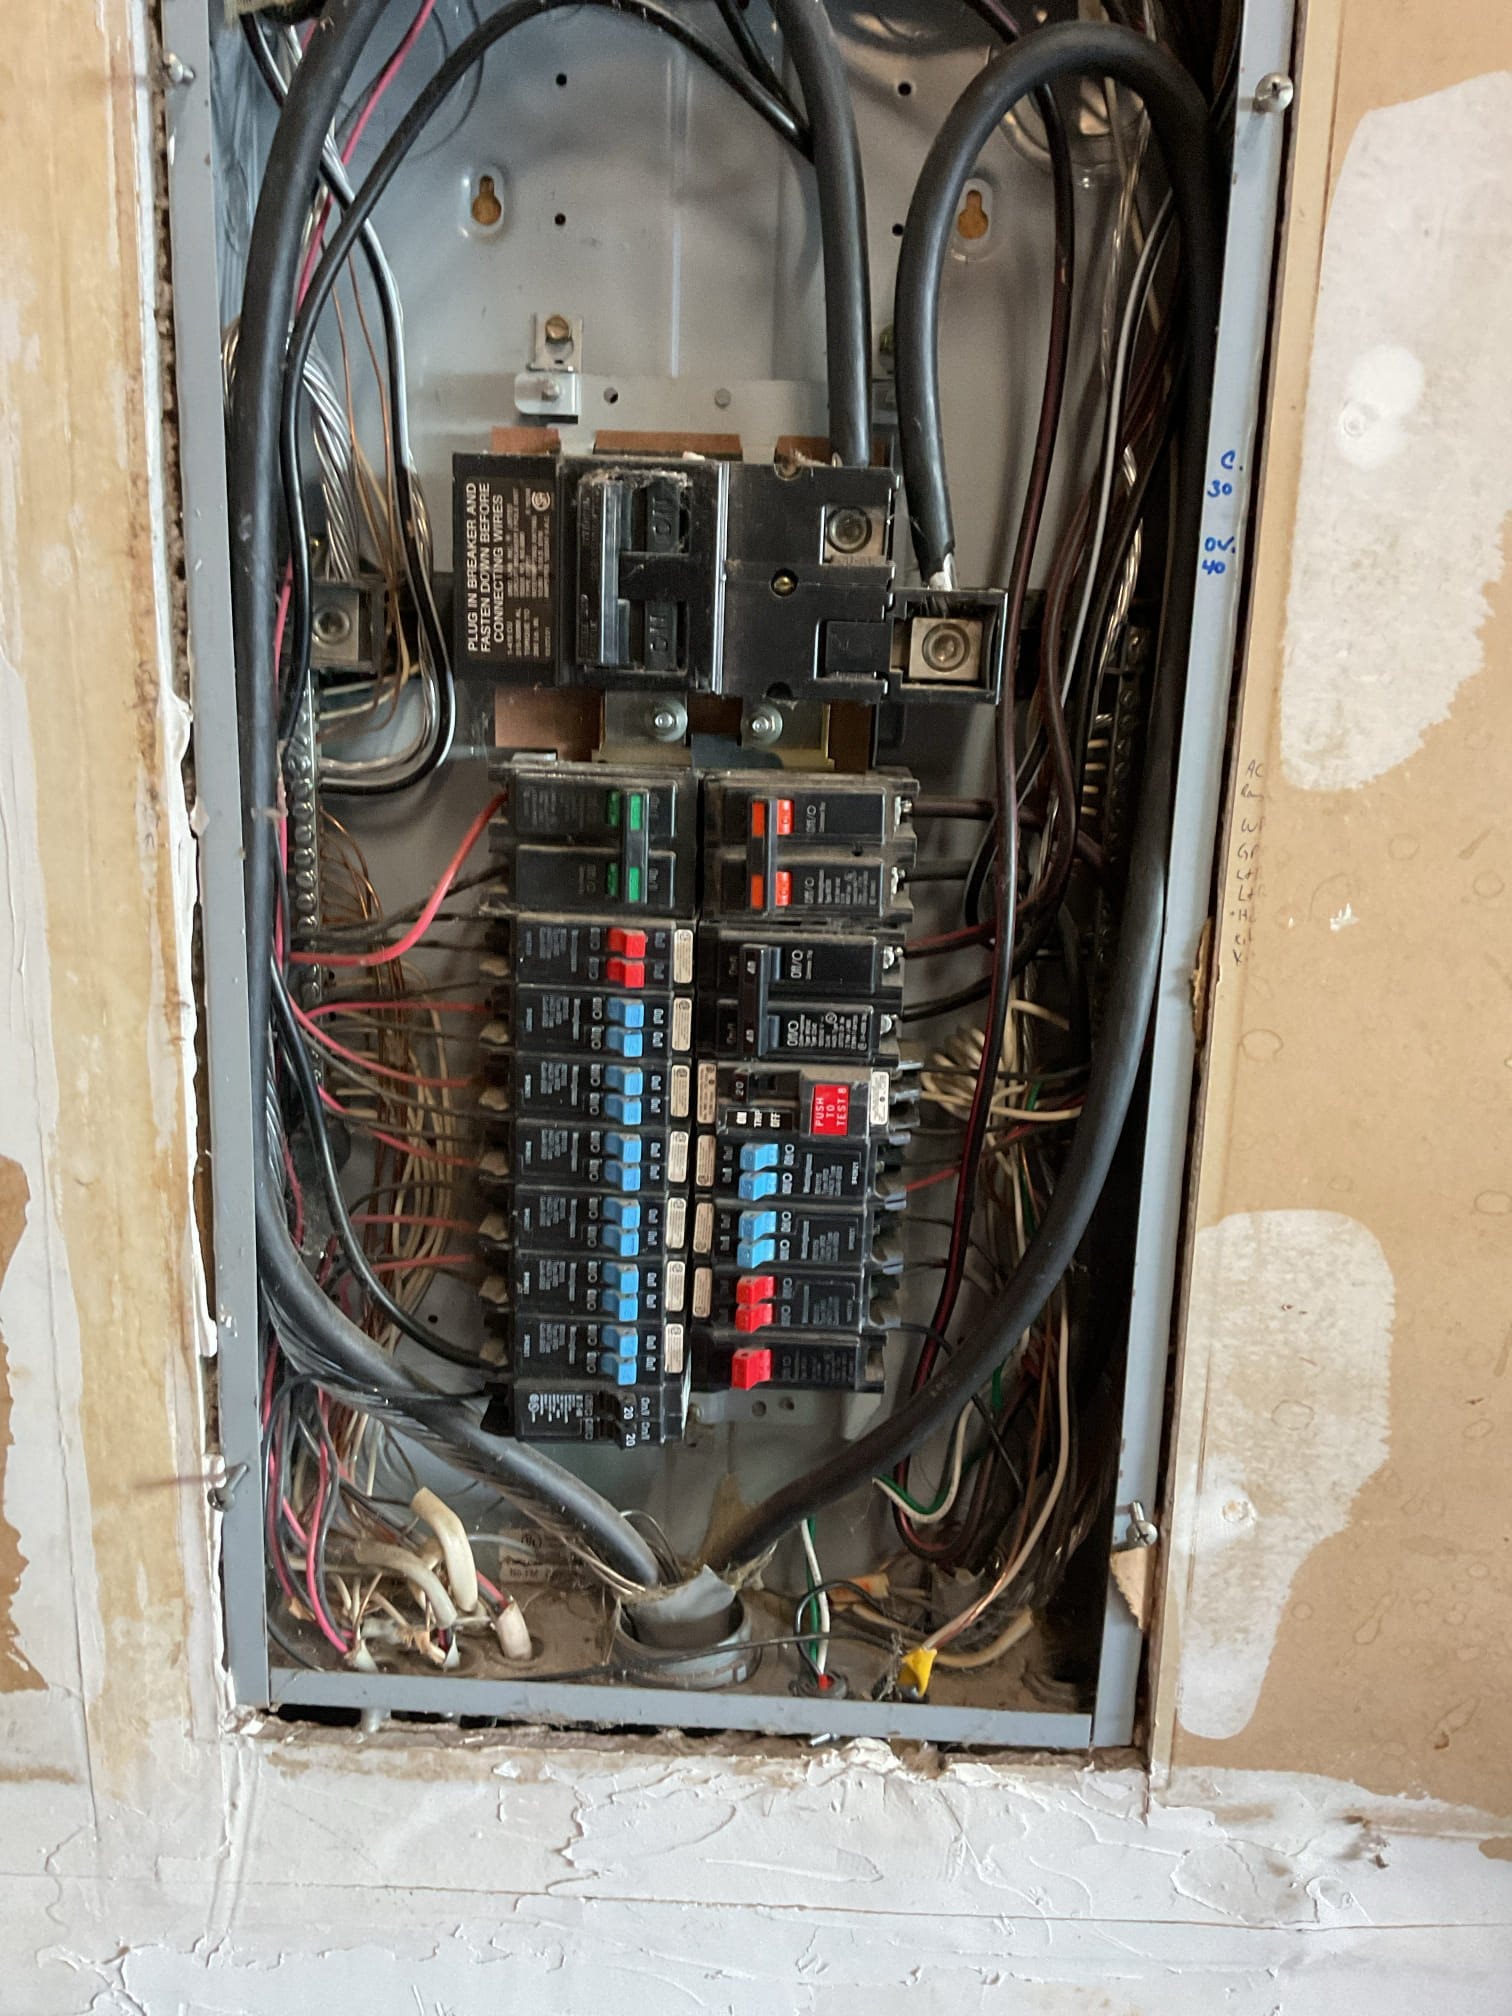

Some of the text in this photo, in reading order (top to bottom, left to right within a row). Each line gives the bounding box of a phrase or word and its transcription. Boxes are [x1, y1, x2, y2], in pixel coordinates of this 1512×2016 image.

[1207, 479, 1233, 498] 30
[466, 482, 478, 651] PLUG IN BREAKER AND
[479, 482, 491, 652] FASTEN DOWN BEFORE
[493, 494, 505, 643] CONNECTING WIRES
[1202, 559, 1226, 575] 40
[1247, 759, 1264, 779] AC
[736, 1081, 744, 1097] 20
[770, 1112, 781, 1128] OFF
[815, 1097, 824, 1127] PUSH
[826, 1104, 835, 1118] TO
[837, 1097, 847, 1126] TEST
[623, 1406, 634, 1419] 20
[626, 1433, 636, 1447] 20
